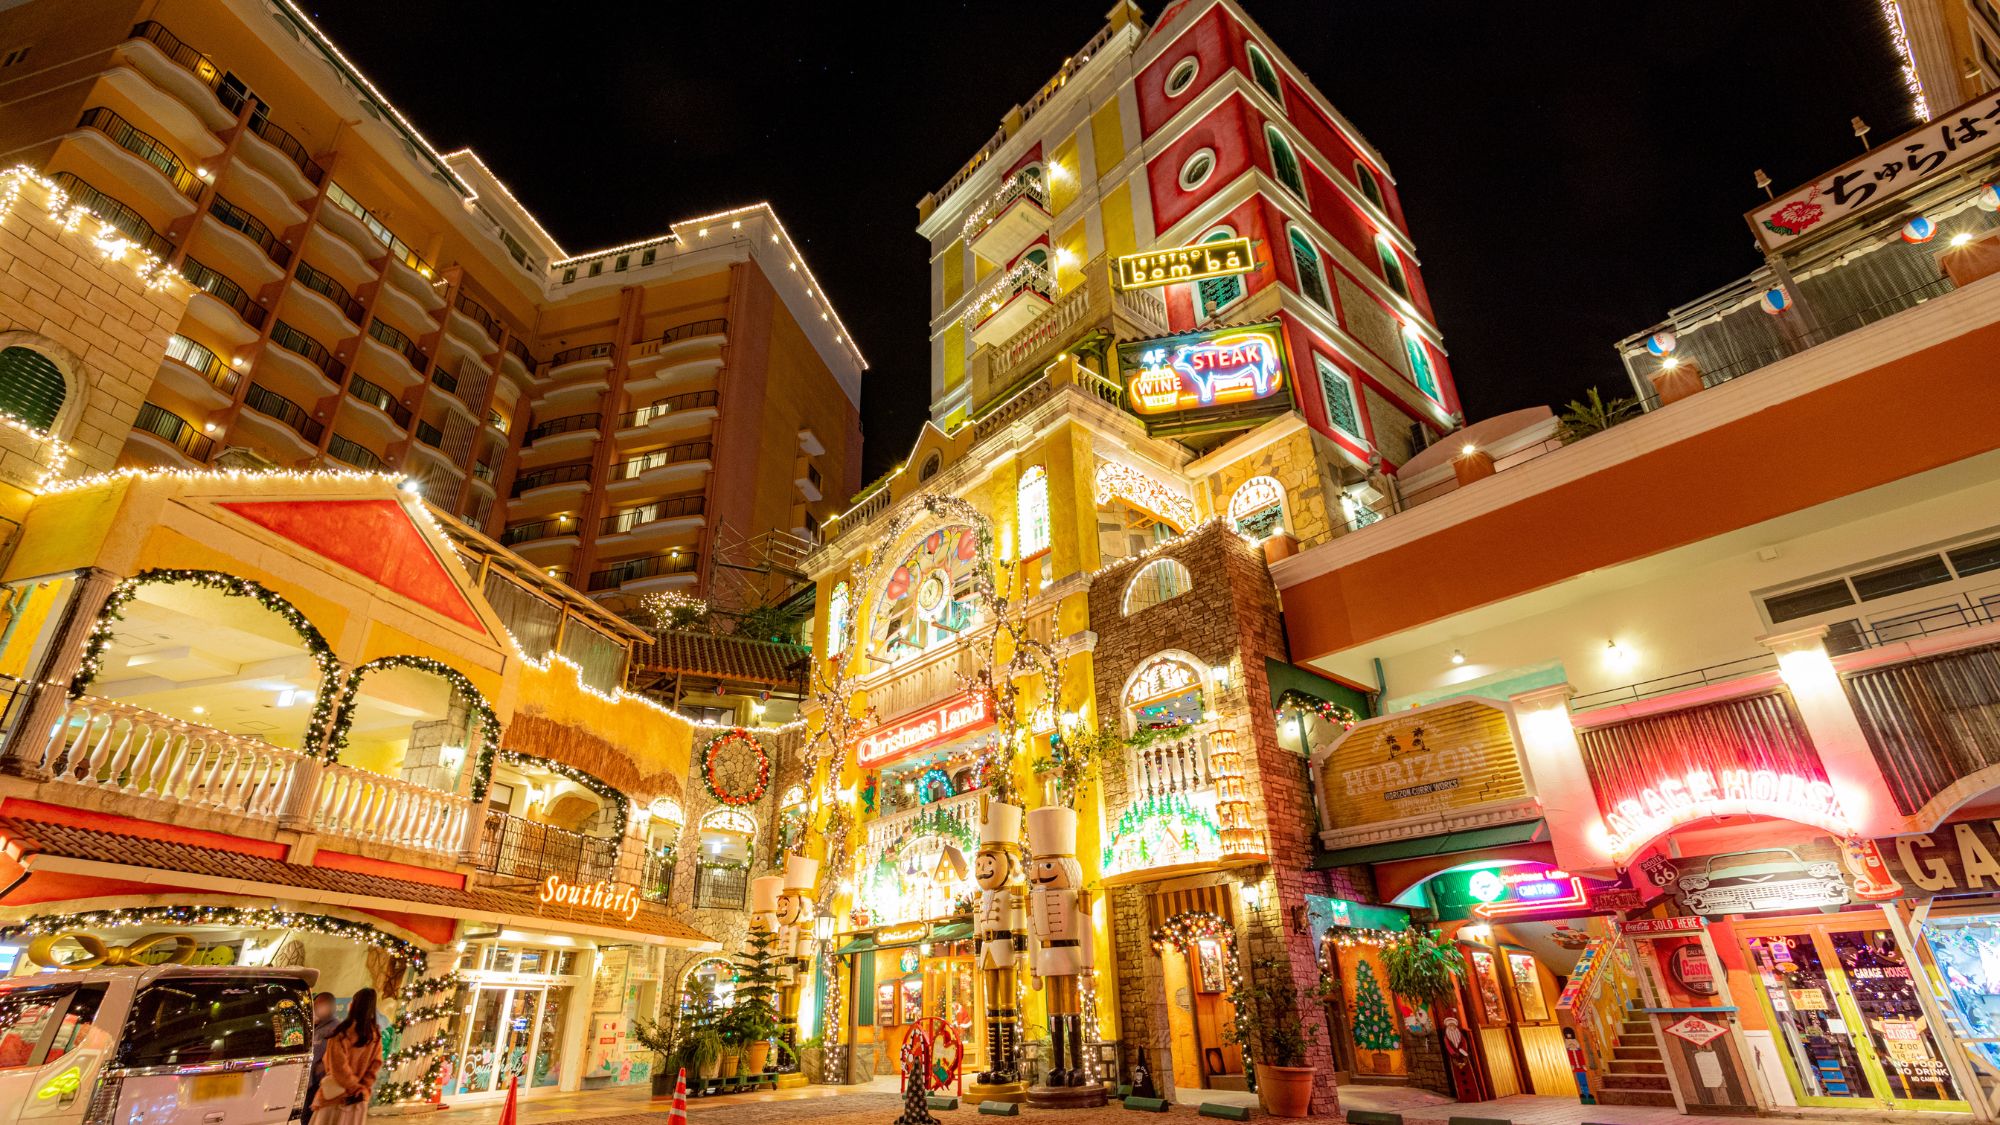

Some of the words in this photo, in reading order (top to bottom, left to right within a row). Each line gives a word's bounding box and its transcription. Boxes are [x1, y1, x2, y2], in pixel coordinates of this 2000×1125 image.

[1823, 99, 2000, 209] ちゅらは
[1139, 249, 1201, 268] BISTRO
[1143, 349, 1166, 363] 4F
[1192, 346, 1260, 370] STEAK
[1137, 377, 1182, 395] WINE
[859, 719, 937, 762] Christmas
[939, 692, 985, 733] Land
[1342, 742, 1488, 796] HORIZON
[1384, 787, 1412, 800] HORIZON
[1411, 783, 1433, 796] CURRY
[1433, 779, 1458, 791] WORKS
[1642, 855, 1663, 869] ROUTE
[1895, 821, 2000, 892] GA
[1654, 867, 1676, 885] 66
[540, 875, 641, 922] Southerly
[1625, 921, 1650, 932] Coca-Cola
[1653, 919, 1674, 931] SOLD
[1676, 917, 1699, 929] HERE
[1853, 967, 1884, 979] GARAGE
[1883, 966, 1908, 978] HOUSE
[1884, 1028, 1918, 1040] CLOSED
[1893, 1060, 1909, 1068] NO
[1913, 1060, 1944, 1068] FOOD
[1896, 1068, 1912, 1076] NO
[1915, 1068, 1949, 1076] DRINK
